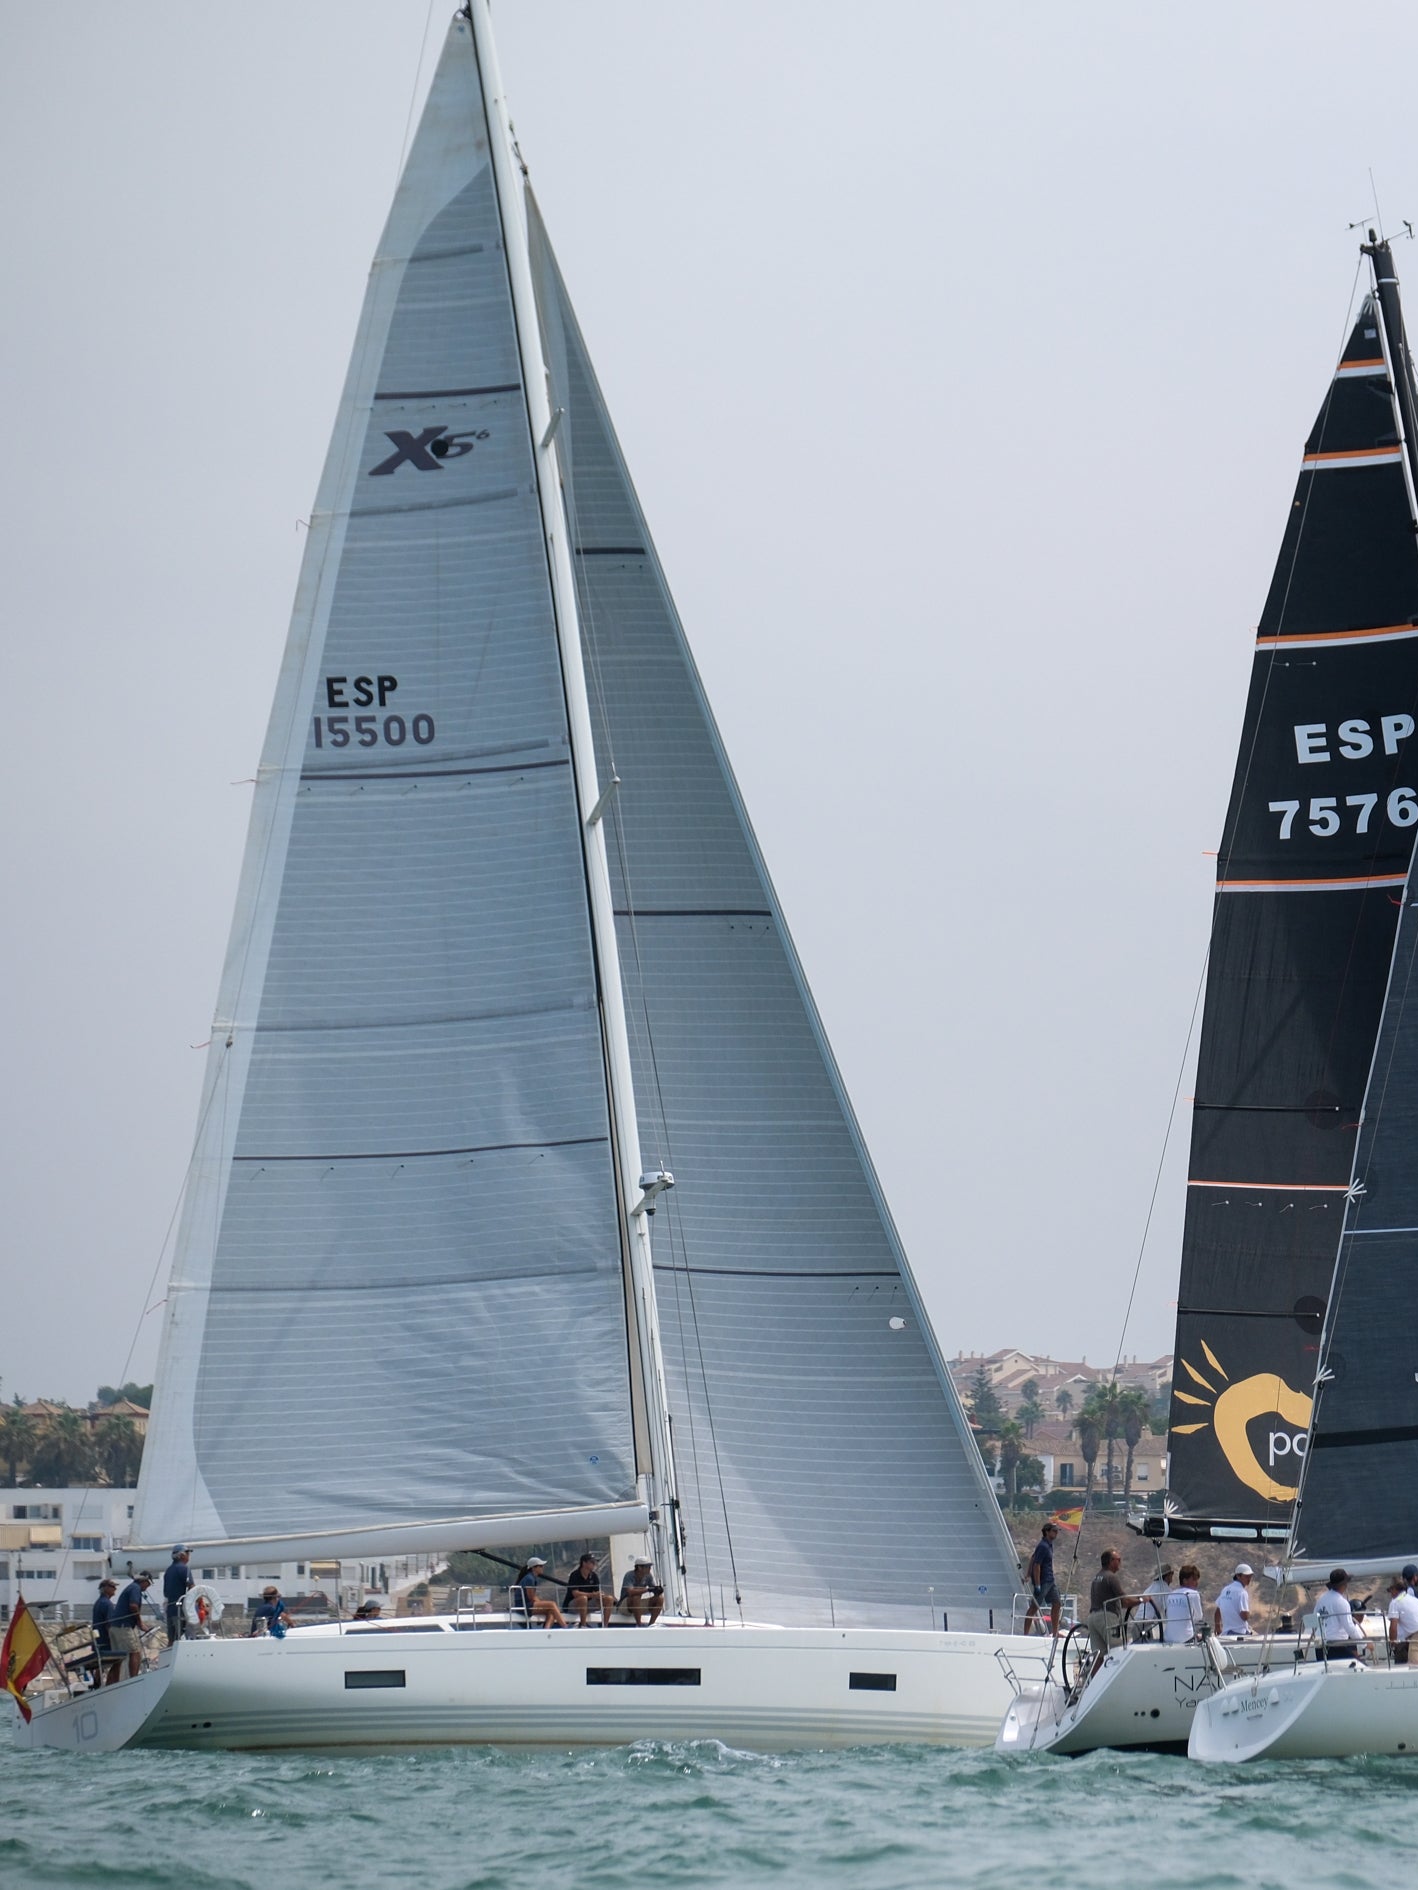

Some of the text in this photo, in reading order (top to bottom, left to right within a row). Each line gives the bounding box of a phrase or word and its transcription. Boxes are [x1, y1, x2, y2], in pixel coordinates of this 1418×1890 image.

[326, 675, 398, 708] ESP
[313, 713, 436, 748] 15500
[1294, 713, 1416, 764] ESP
